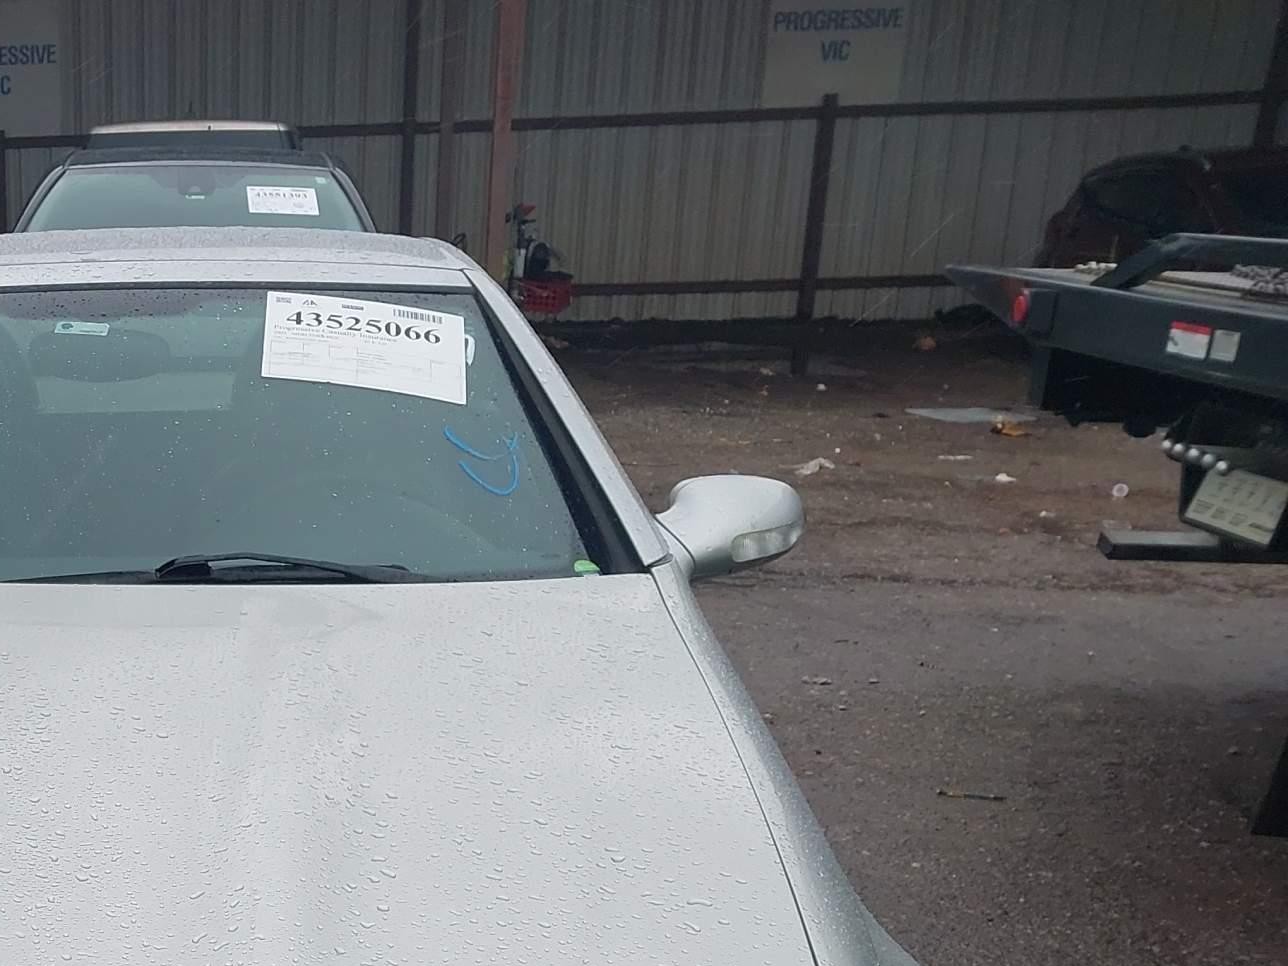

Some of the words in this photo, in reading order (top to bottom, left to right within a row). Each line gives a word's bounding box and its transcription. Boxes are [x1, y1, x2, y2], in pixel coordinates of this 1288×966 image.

[775, 8, 904, 31] PROGRESSIVE
[821, 40, 850, 61] VIC
[286, 311, 441, 344] 43525066
